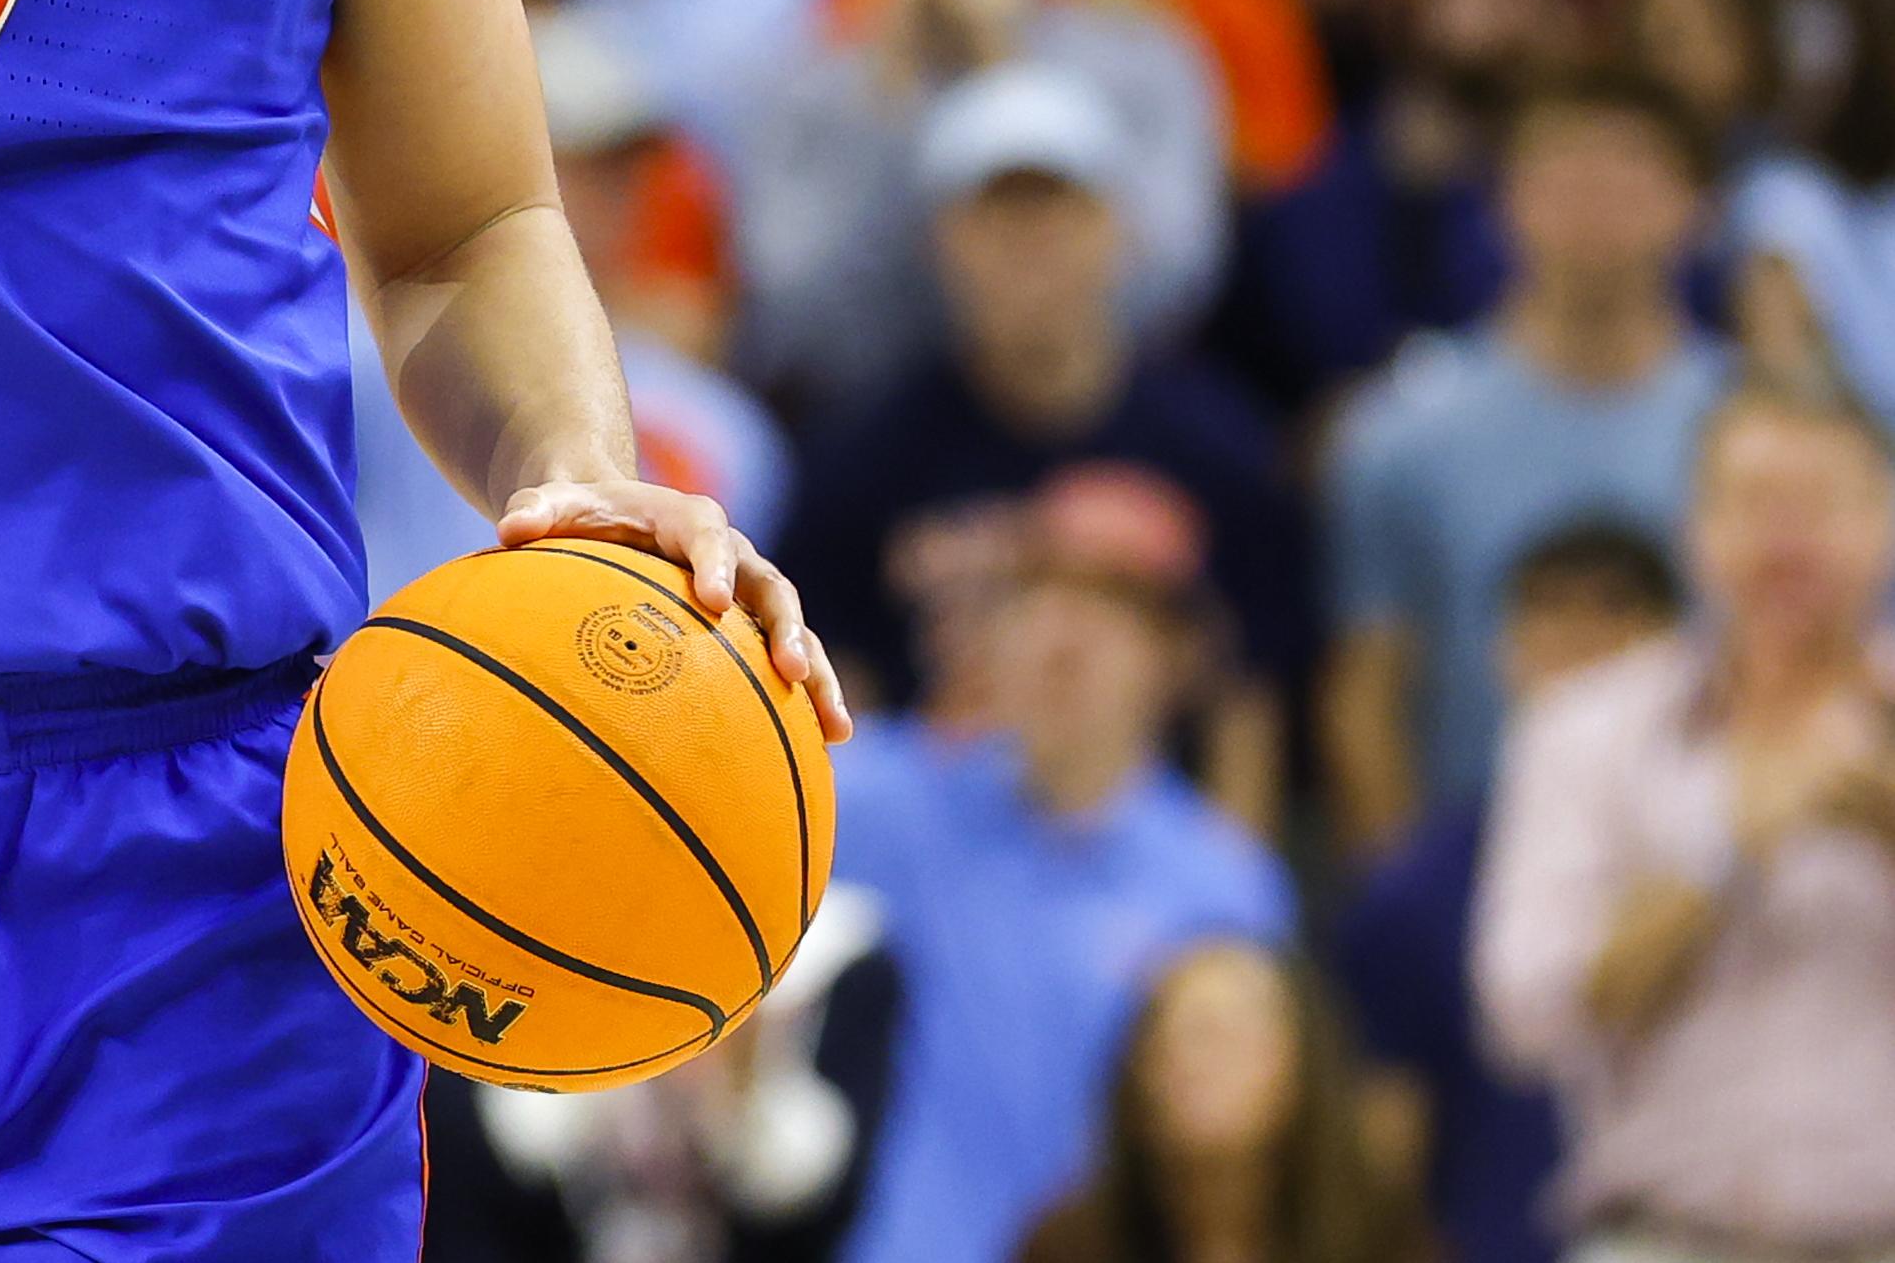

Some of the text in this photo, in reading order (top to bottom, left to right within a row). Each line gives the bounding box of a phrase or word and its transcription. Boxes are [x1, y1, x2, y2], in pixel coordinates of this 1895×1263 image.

[308, 848, 528, 1045] NCAA
[330, 832, 535, 999] OFFICIAL GAME BALL
